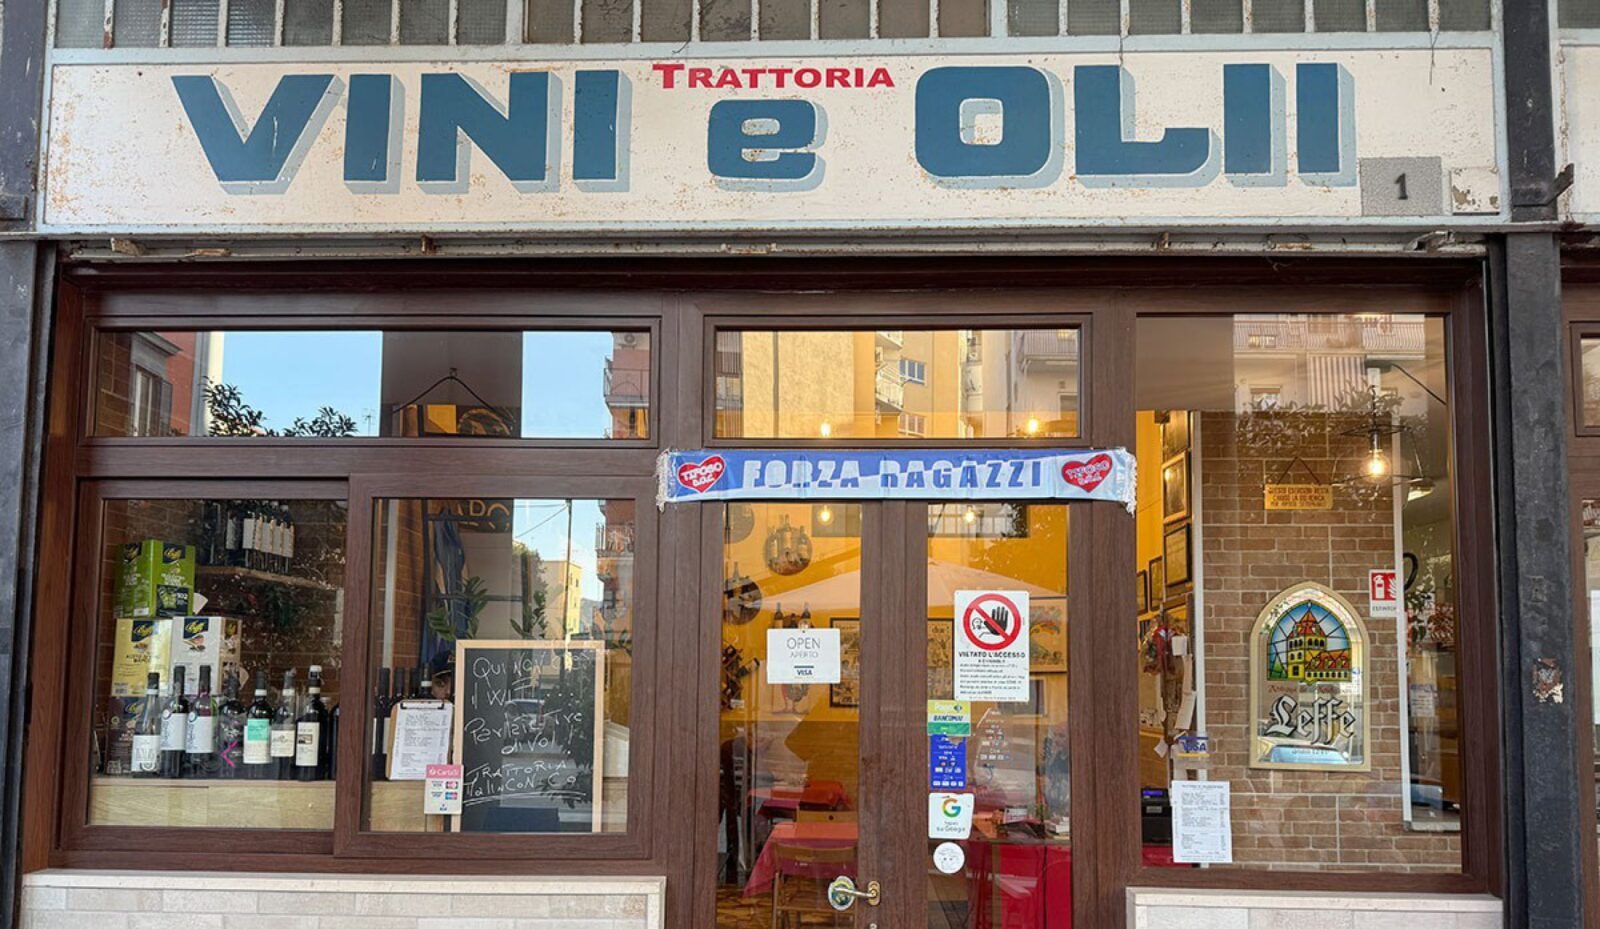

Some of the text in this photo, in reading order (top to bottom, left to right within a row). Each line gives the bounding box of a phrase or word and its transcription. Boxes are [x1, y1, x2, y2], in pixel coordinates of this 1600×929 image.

[171, 62, 1357, 194] VINI e OLII
[1397, 172, 1409, 201] 1
[743, 459, 1042, 489] FORZA RAGAZZI
[786, 637, 820, 650] OPEN
[789, 650, 819, 659] APERTO
[1264, 694, 1356, 746] Leffe
